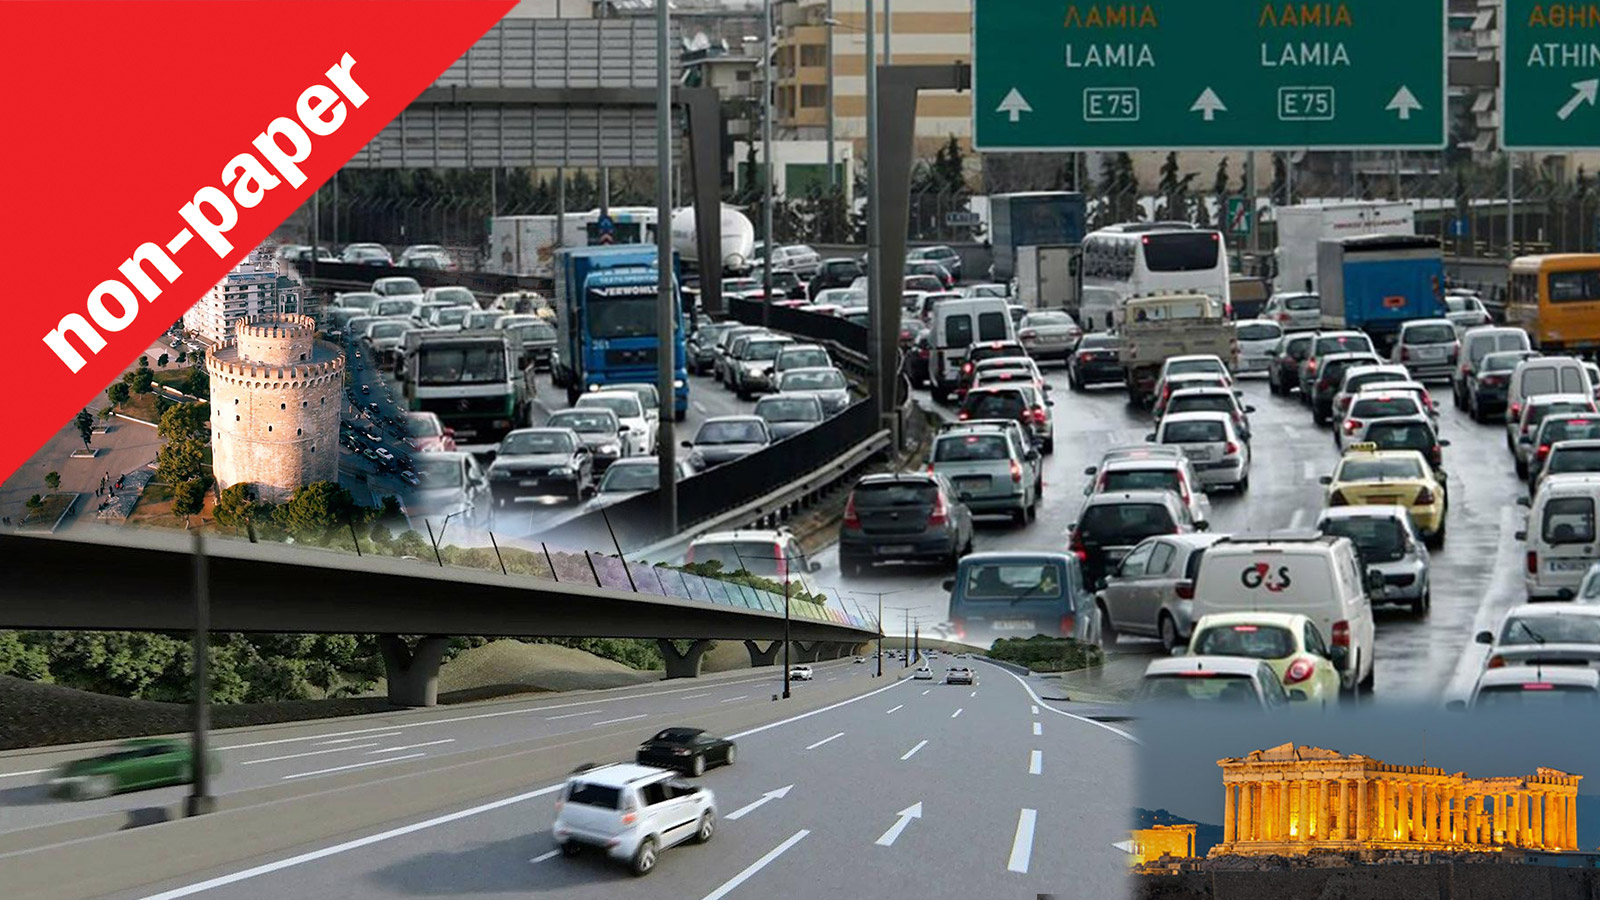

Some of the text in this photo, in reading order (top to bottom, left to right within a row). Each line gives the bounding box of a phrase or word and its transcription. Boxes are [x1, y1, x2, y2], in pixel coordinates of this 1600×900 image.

[1063, 4, 1159, 29] ΛΑΜΙΑ
[1258, 3, 1353, 28] ΛΑΜΙΑ
[1065, 43, 1156, 68] LAMIA
[1261, 42, 1351, 67] LAMIA
[1090, 94, 1134, 115] E 75
[1284, 93, 1329, 114] E 75
[1241, 562, 1291, 592] G4S
